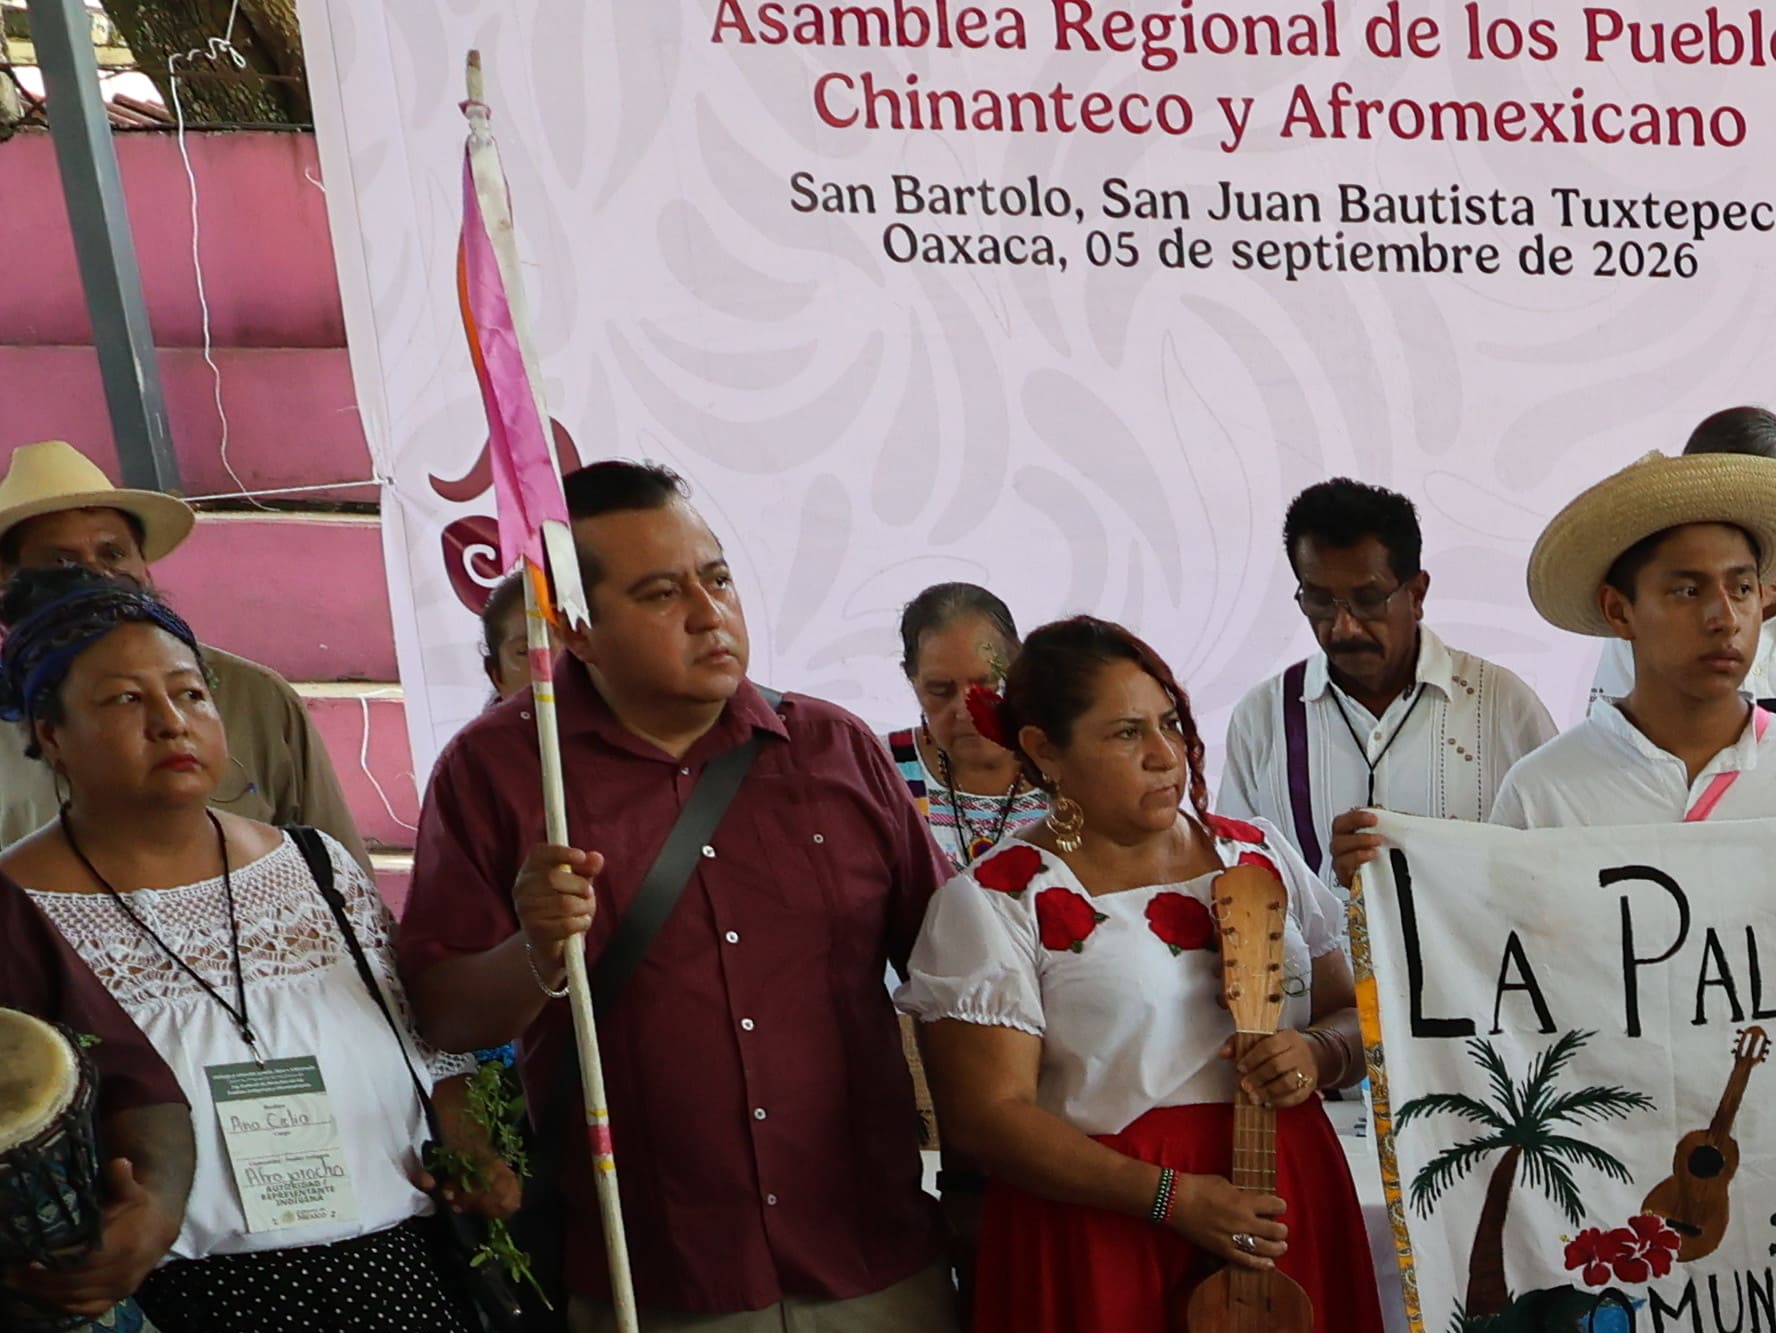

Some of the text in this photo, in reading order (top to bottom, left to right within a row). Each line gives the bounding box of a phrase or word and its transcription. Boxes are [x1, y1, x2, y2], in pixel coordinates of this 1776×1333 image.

[711, 0, 1027, 50] Asamblea
[1051, 0, 1342, 72] Regional
[1366, 0, 1442, 60] de
[1465, 2, 1560, 62] los
[813, 71, 1749, 154] Chinanteco y Afromexicano
[790, 171, 877, 215] San
[891, 174, 1085, 225] Bartolo,
[1102, 177, 1190, 220] San
[1207, 181, 1322, 224] Juan
[1338, 183, 1536, 227] Bautista
[882, 222, 1706, 282] Oaxaca, 05 de septiembre de 2026
